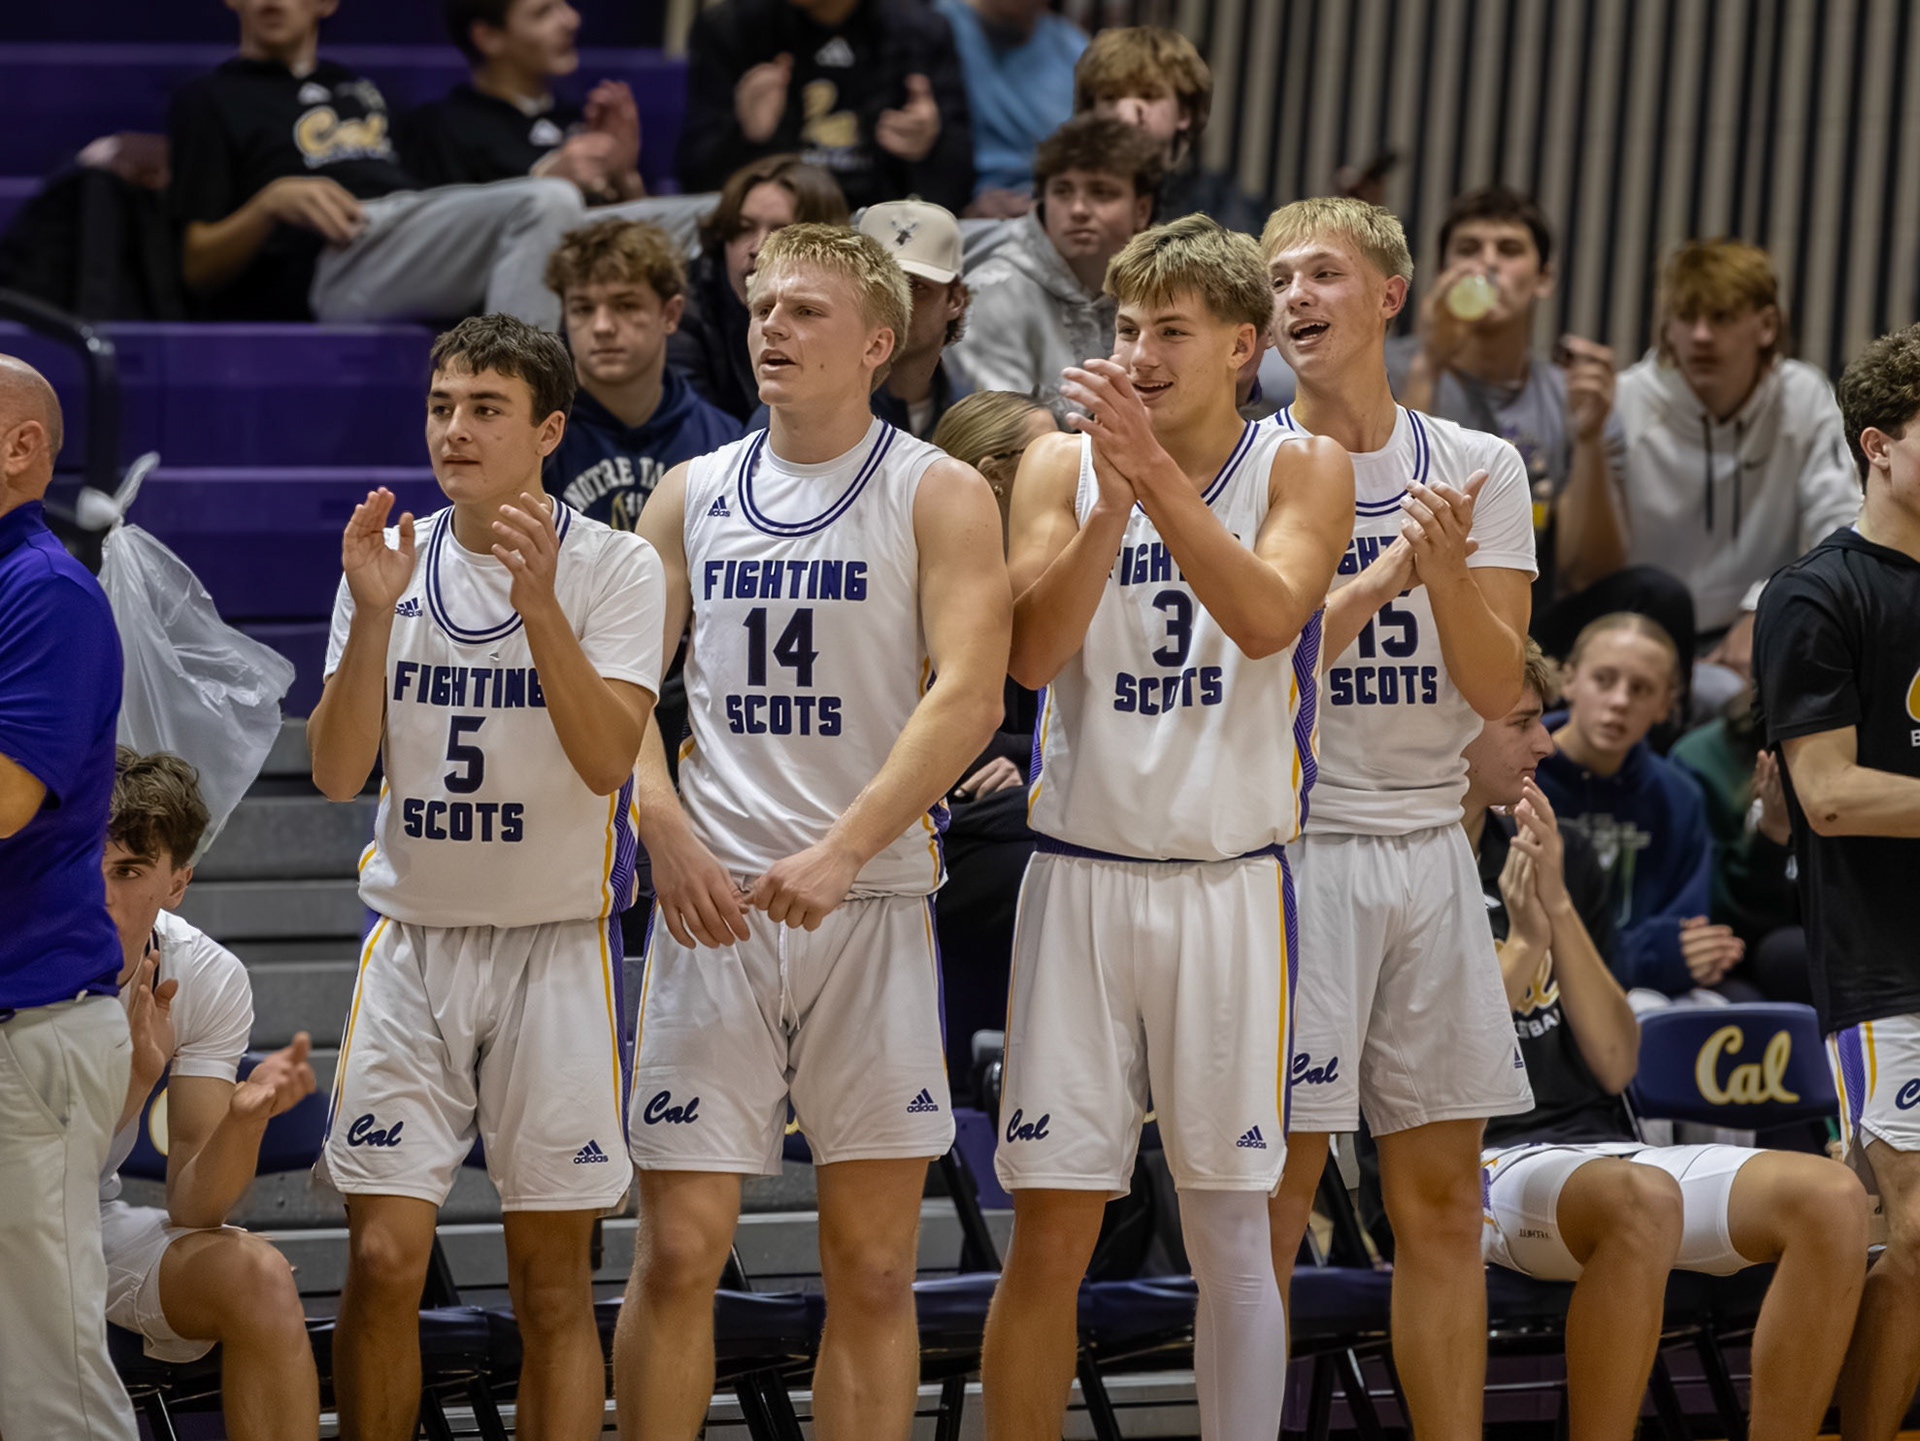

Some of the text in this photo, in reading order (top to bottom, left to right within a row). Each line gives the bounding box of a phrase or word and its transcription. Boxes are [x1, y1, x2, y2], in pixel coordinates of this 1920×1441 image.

[563, 456, 635, 513] NOTRE
[704, 560, 868, 601] FIGHTING
[742, 607, 819, 687] 14
[1152, 590, 1193, 667] 3
[393, 661, 547, 708] FIGHTING
[1114, 666, 1222, 715] SCOTS
[1330, 666, 1437, 705] SCOTS
[726, 694, 842, 736] SCOTS
[444, 715, 486, 793] 5
[403, 798, 524, 842] SCOTS
[1695, 1025, 1800, 1105] Cal
[643, 1090, 700, 1125] Cal
[906, 1104, 939, 1113] adidas
[1006, 1108, 1050, 1143] Cal
[347, 1113, 404, 1147] Cal
[1236, 1139, 1267, 1149] adidas
[573, 1154, 609, 1164] adidas
